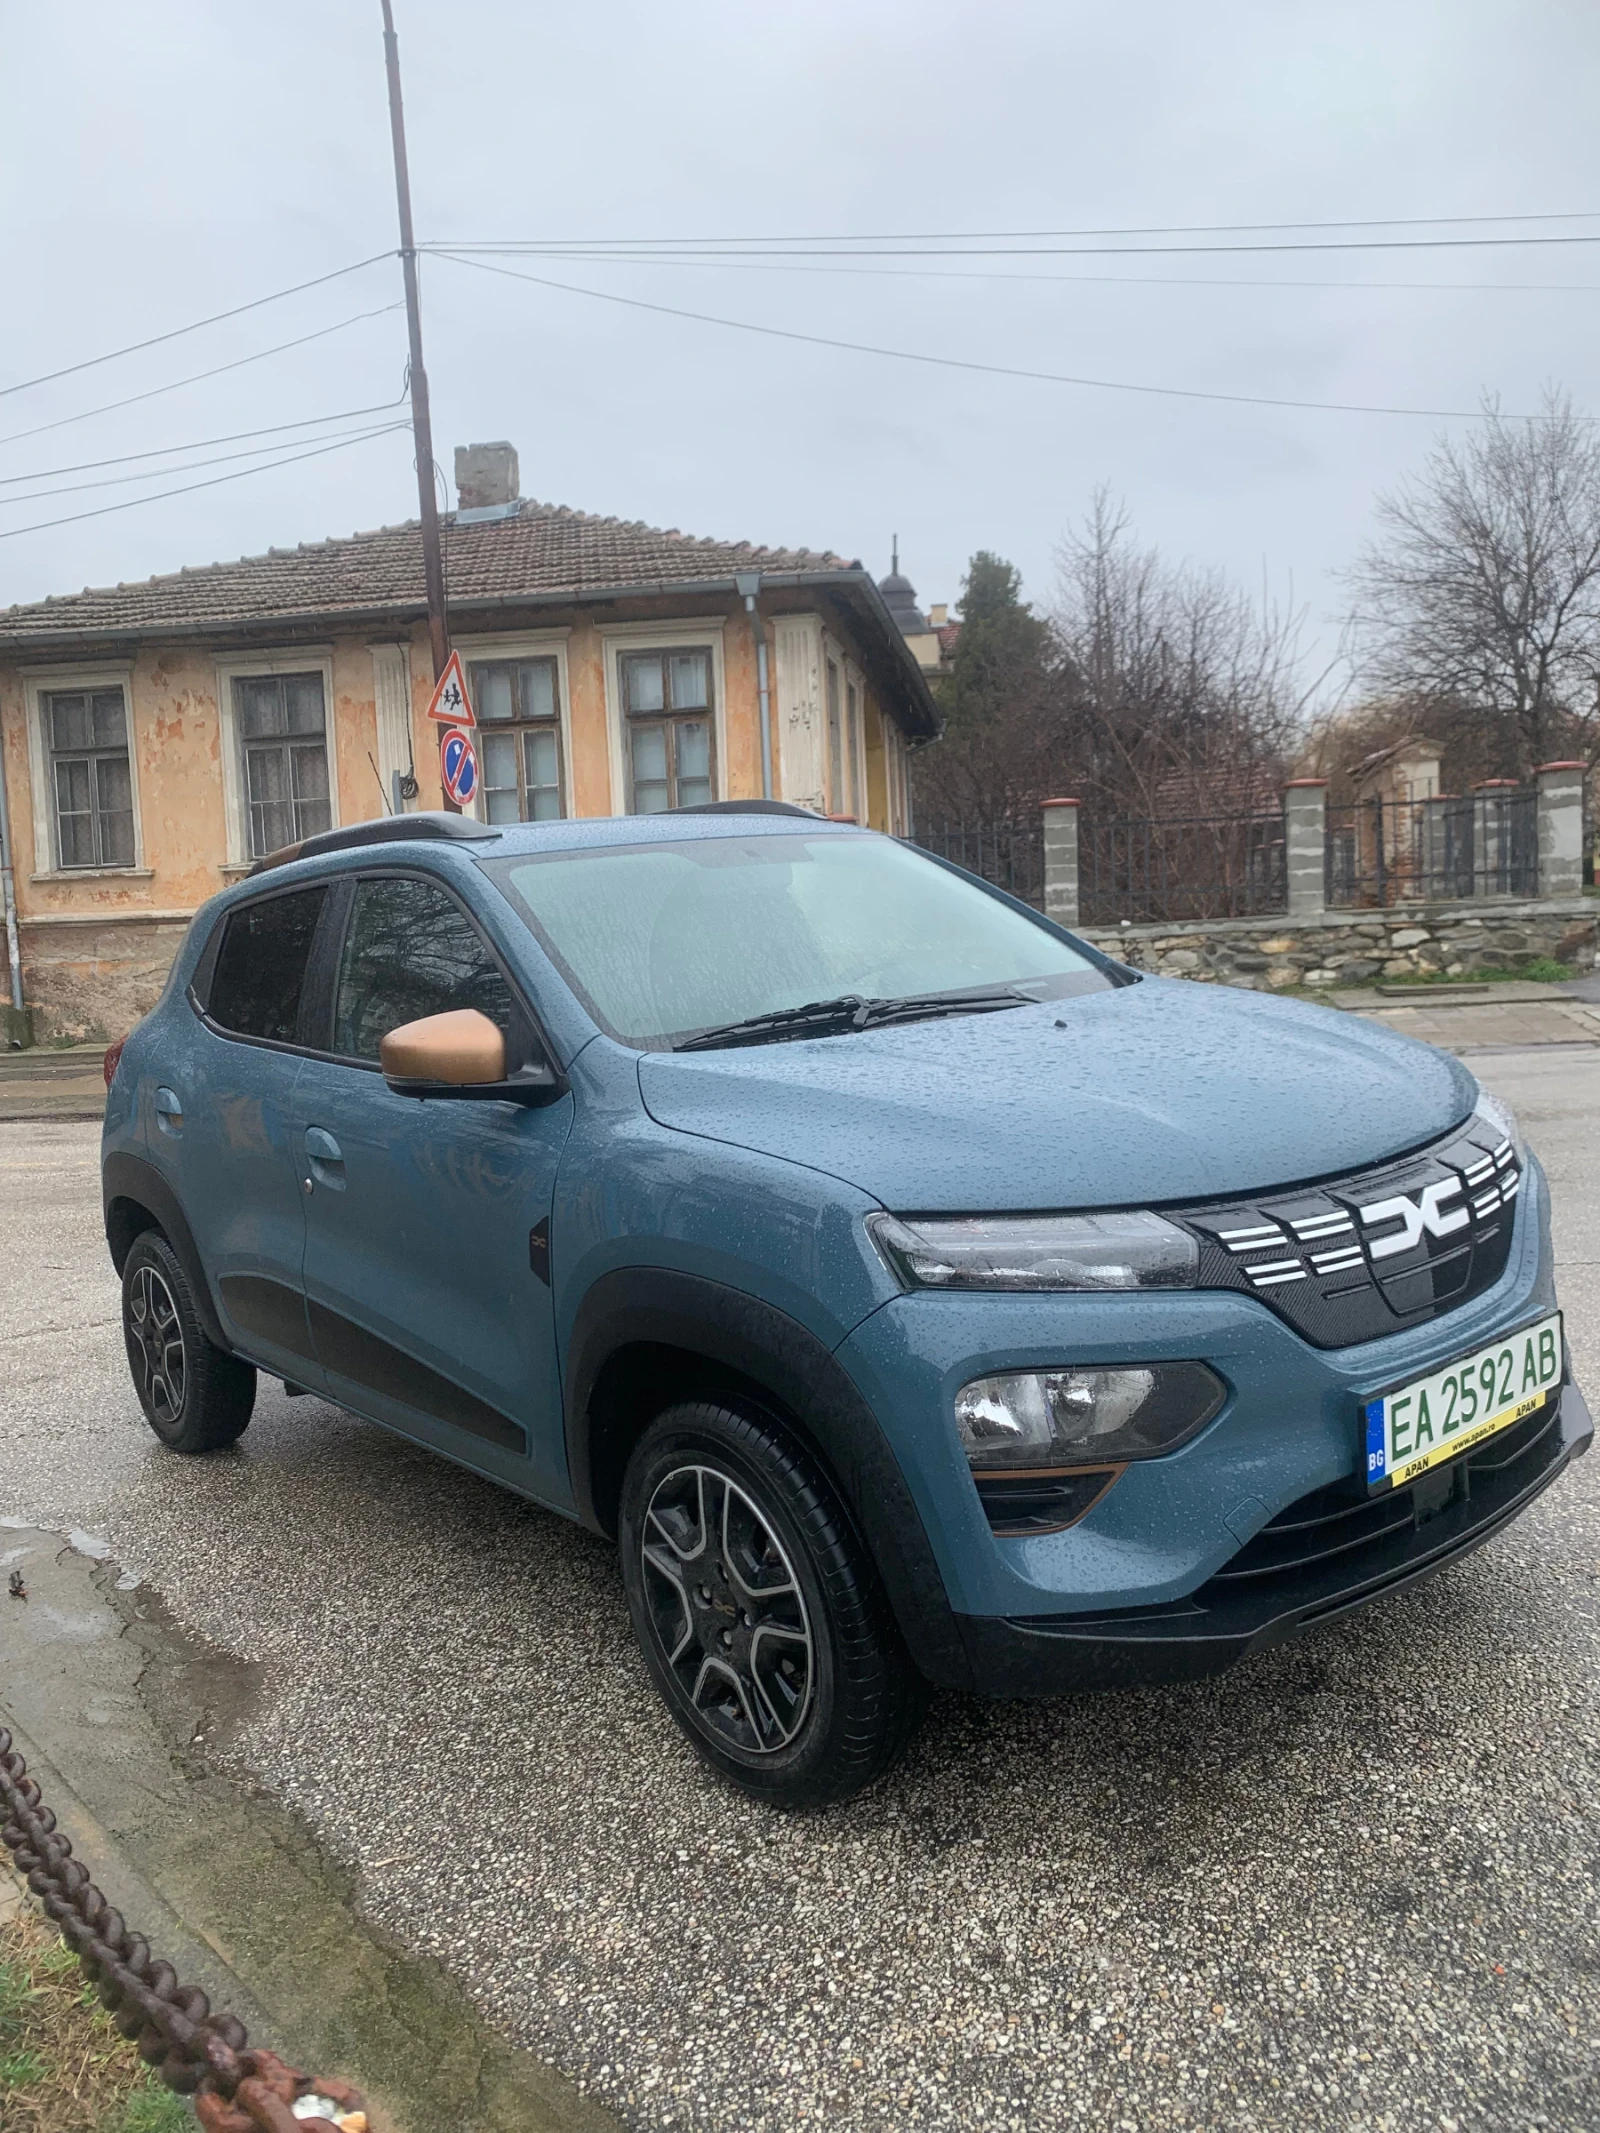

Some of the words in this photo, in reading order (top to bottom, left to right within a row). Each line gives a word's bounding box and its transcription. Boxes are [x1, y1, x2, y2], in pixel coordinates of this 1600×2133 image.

[1391, 1389, 1434, 1461] EA
[1441, 1348, 1514, 1435] 2592
[1521, 1328, 1556, 1394] AB
[1368, 1450, 1384, 1471] BG
[1404, 1456, 1429, 1479] APAN
[1452, 1423, 1495, 1452] www.apan.ro
[1515, 1399, 1536, 1418] APAN
